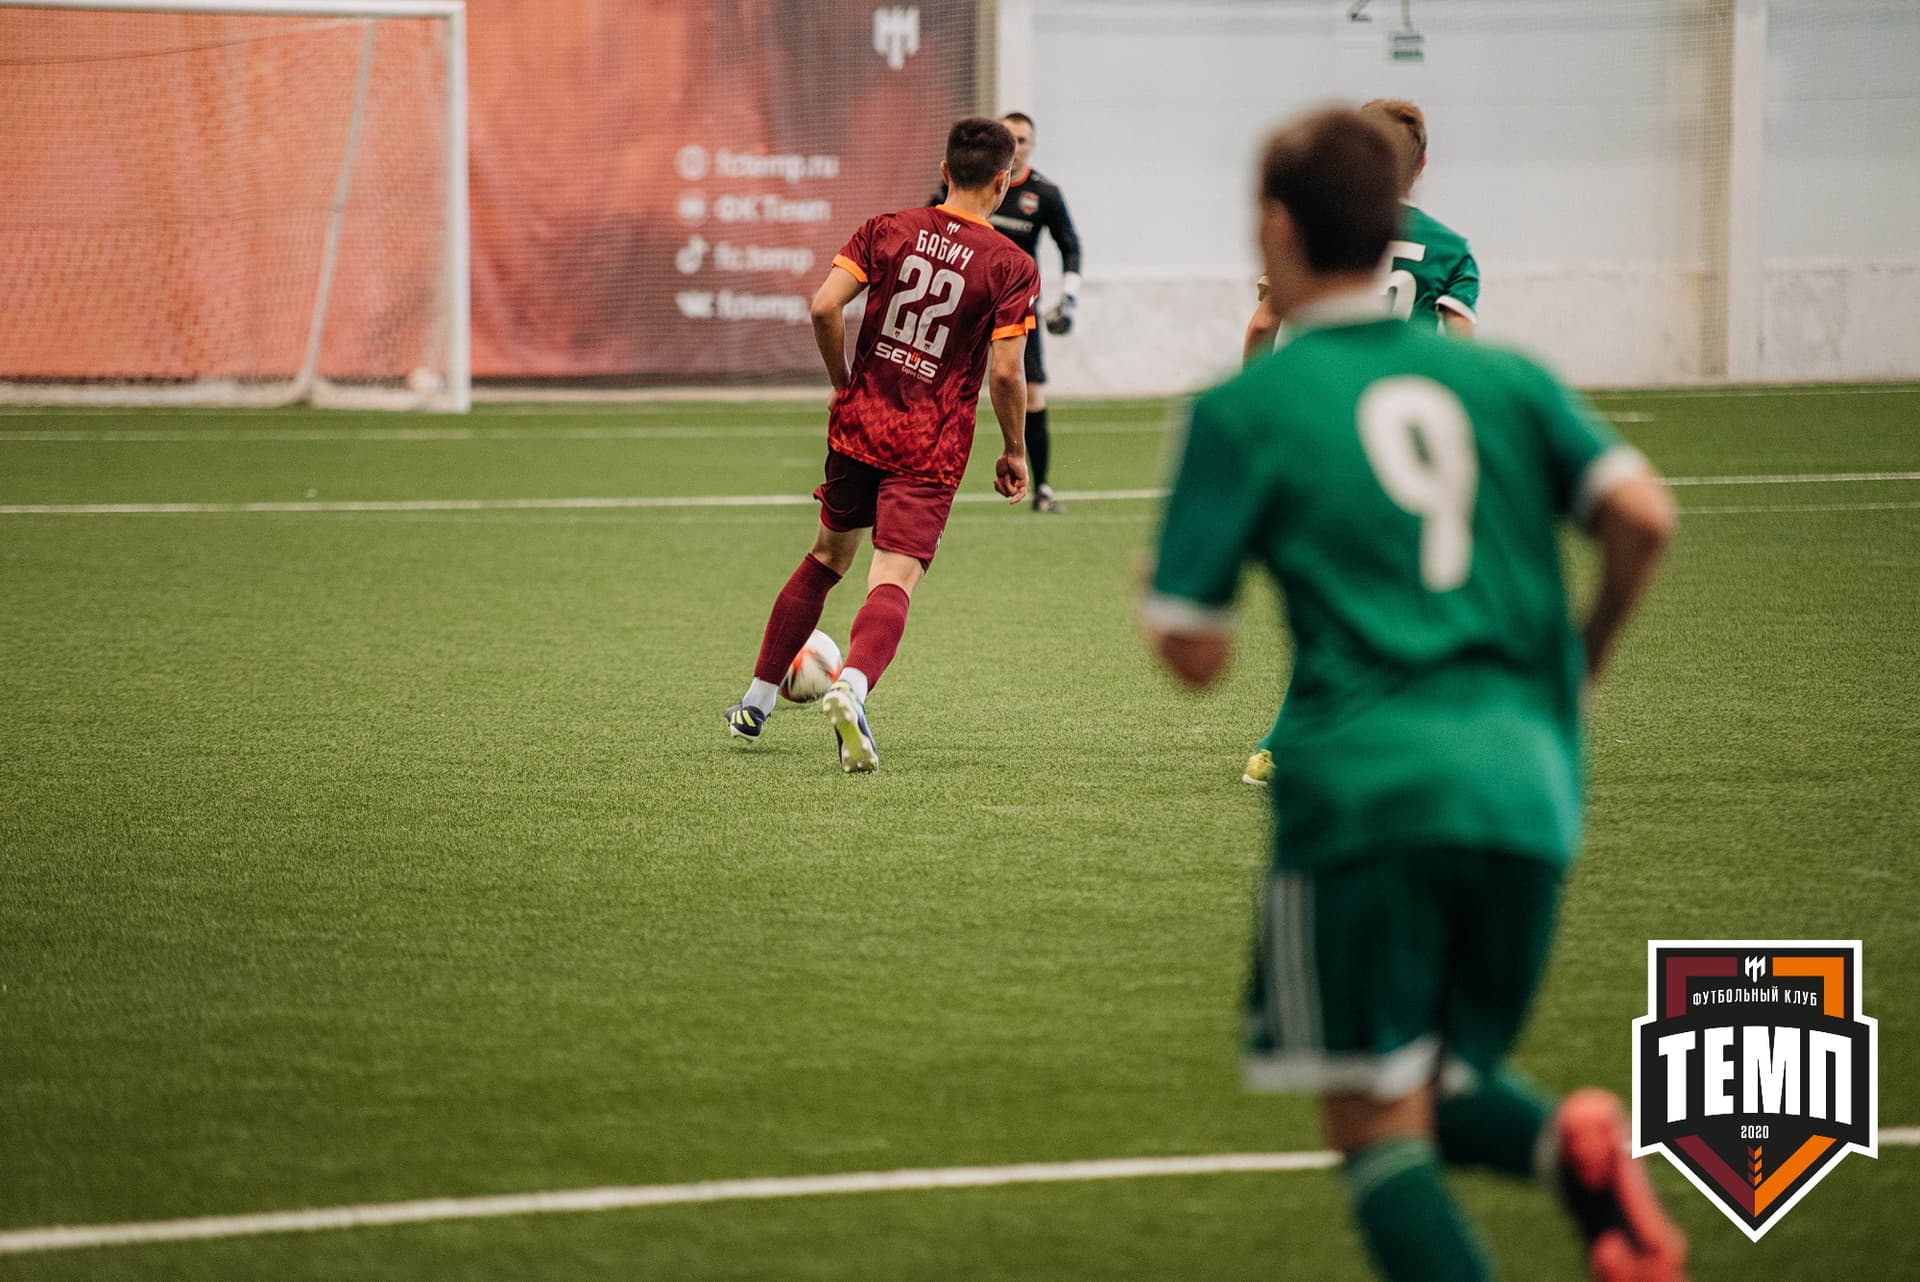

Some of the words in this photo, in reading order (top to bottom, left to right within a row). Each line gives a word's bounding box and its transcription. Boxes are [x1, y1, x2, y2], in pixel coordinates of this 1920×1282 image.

[916, 229, 974, 271] БАБИЧ
[881, 254, 966, 360] 22
[874, 341, 938, 378] SEUS
[1357, 375, 1479, 591] 9
